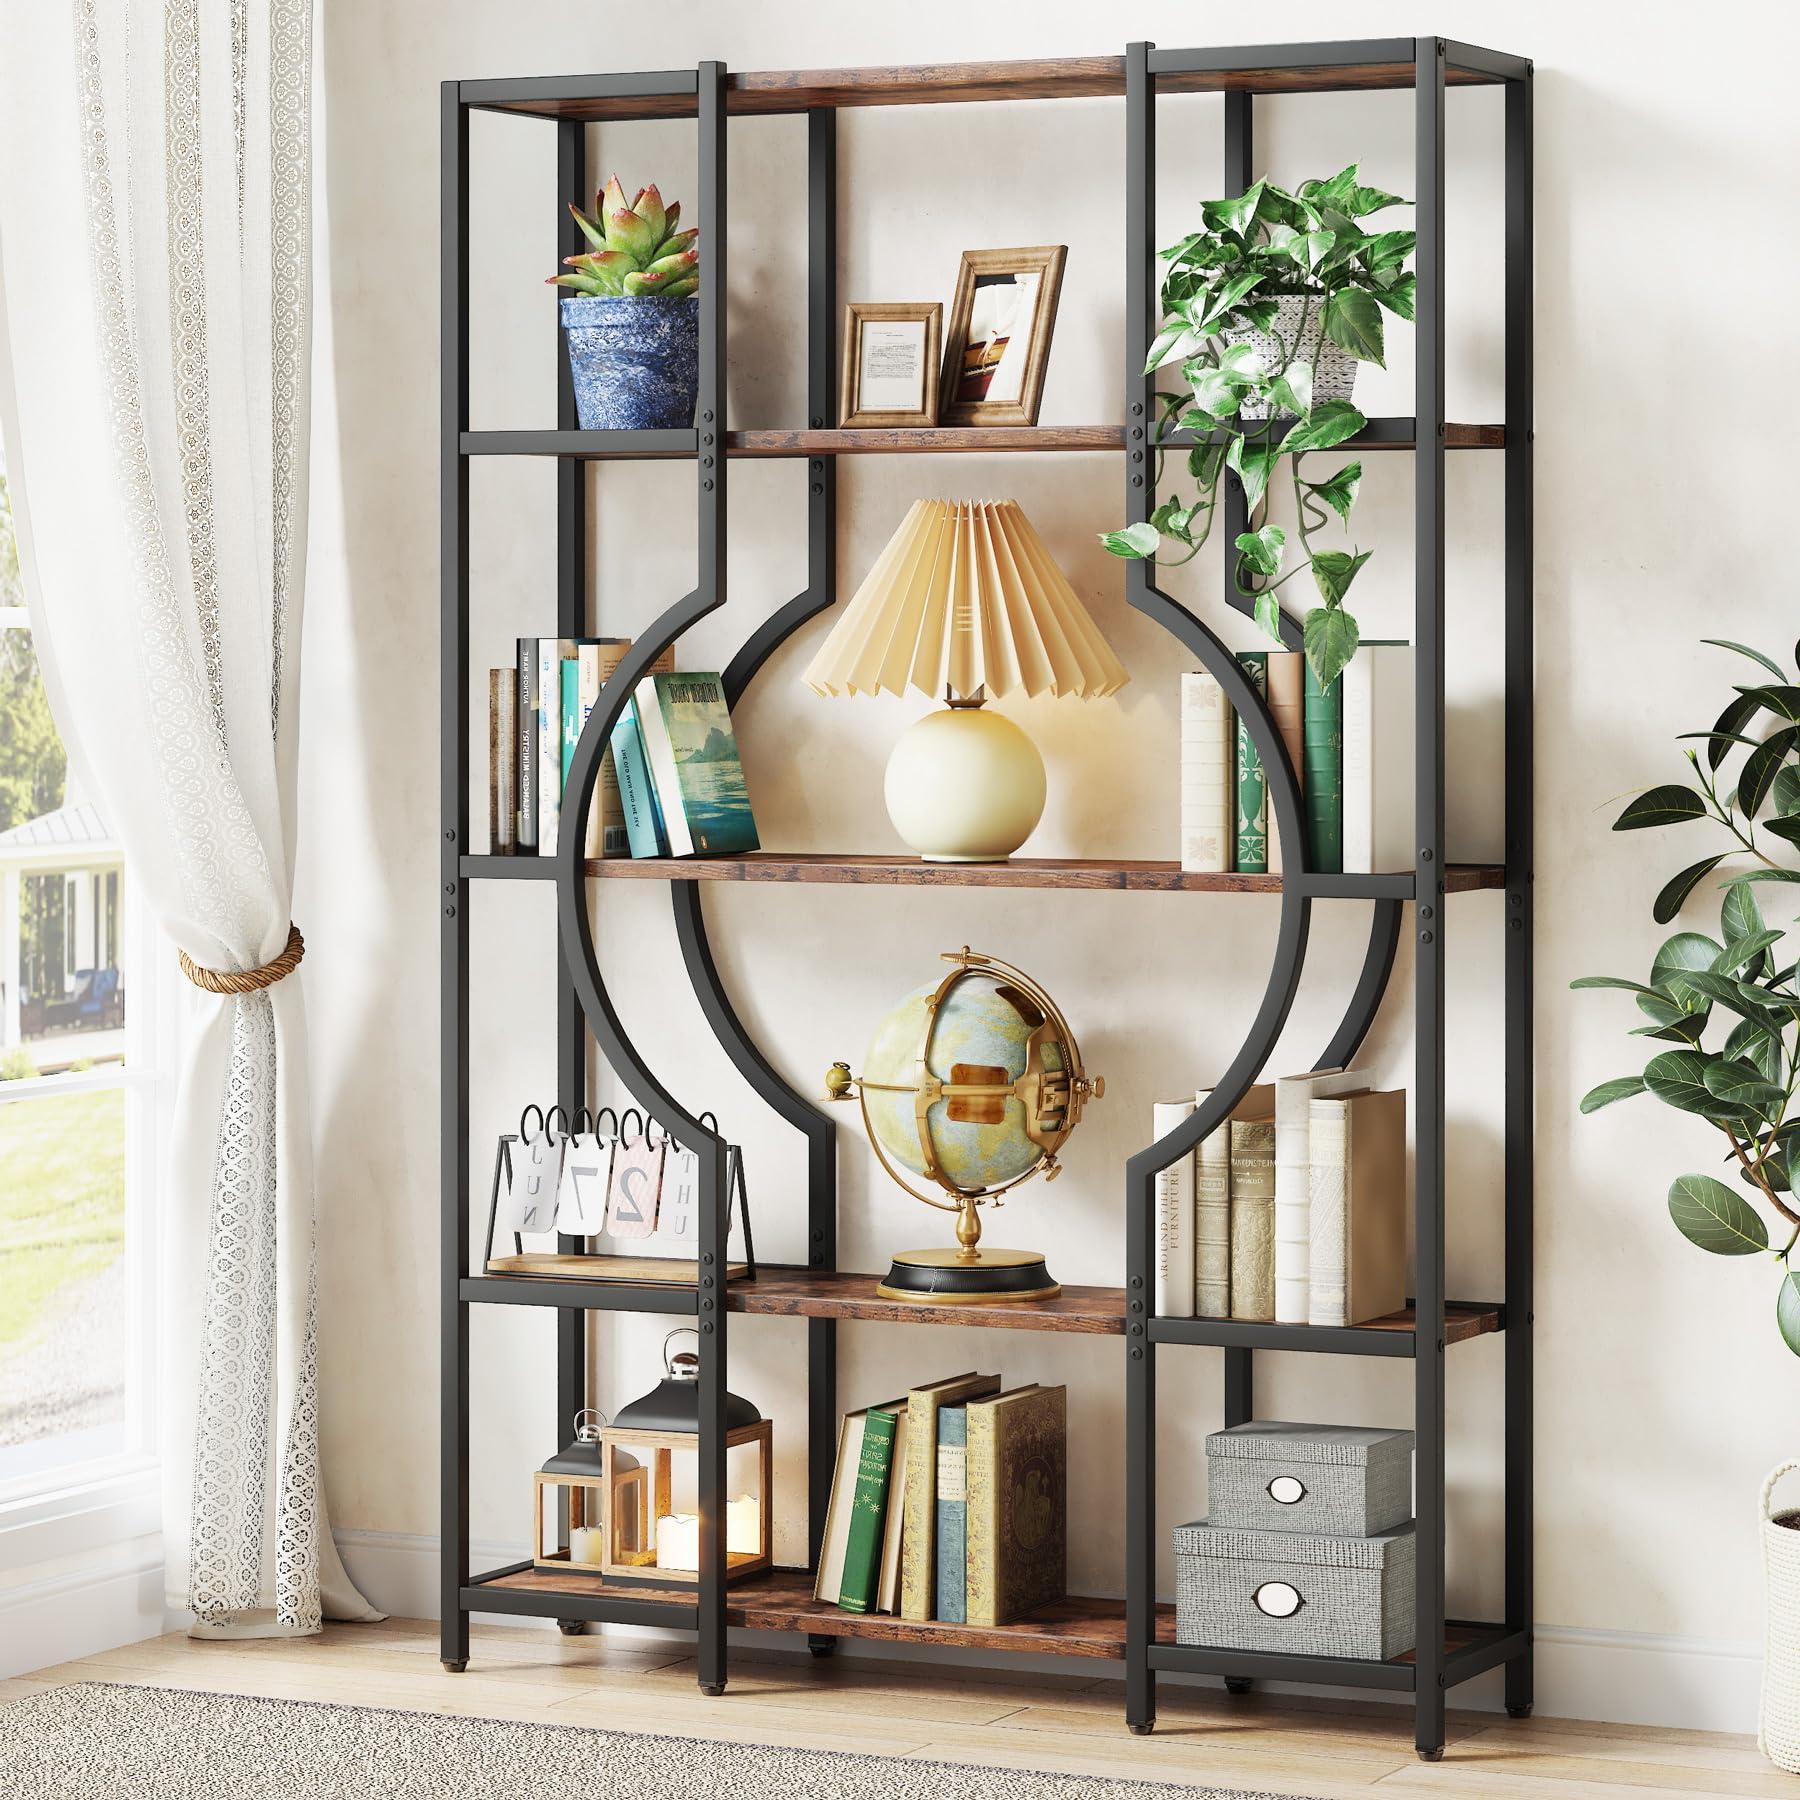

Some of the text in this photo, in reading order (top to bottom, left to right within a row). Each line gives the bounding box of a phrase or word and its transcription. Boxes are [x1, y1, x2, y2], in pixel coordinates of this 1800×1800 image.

[1160, 1187, 1169, 1216] THE
[1169, 1168, 1179, 1250] FURNITURE
[1160, 1222, 1169, 1282] AROUND
